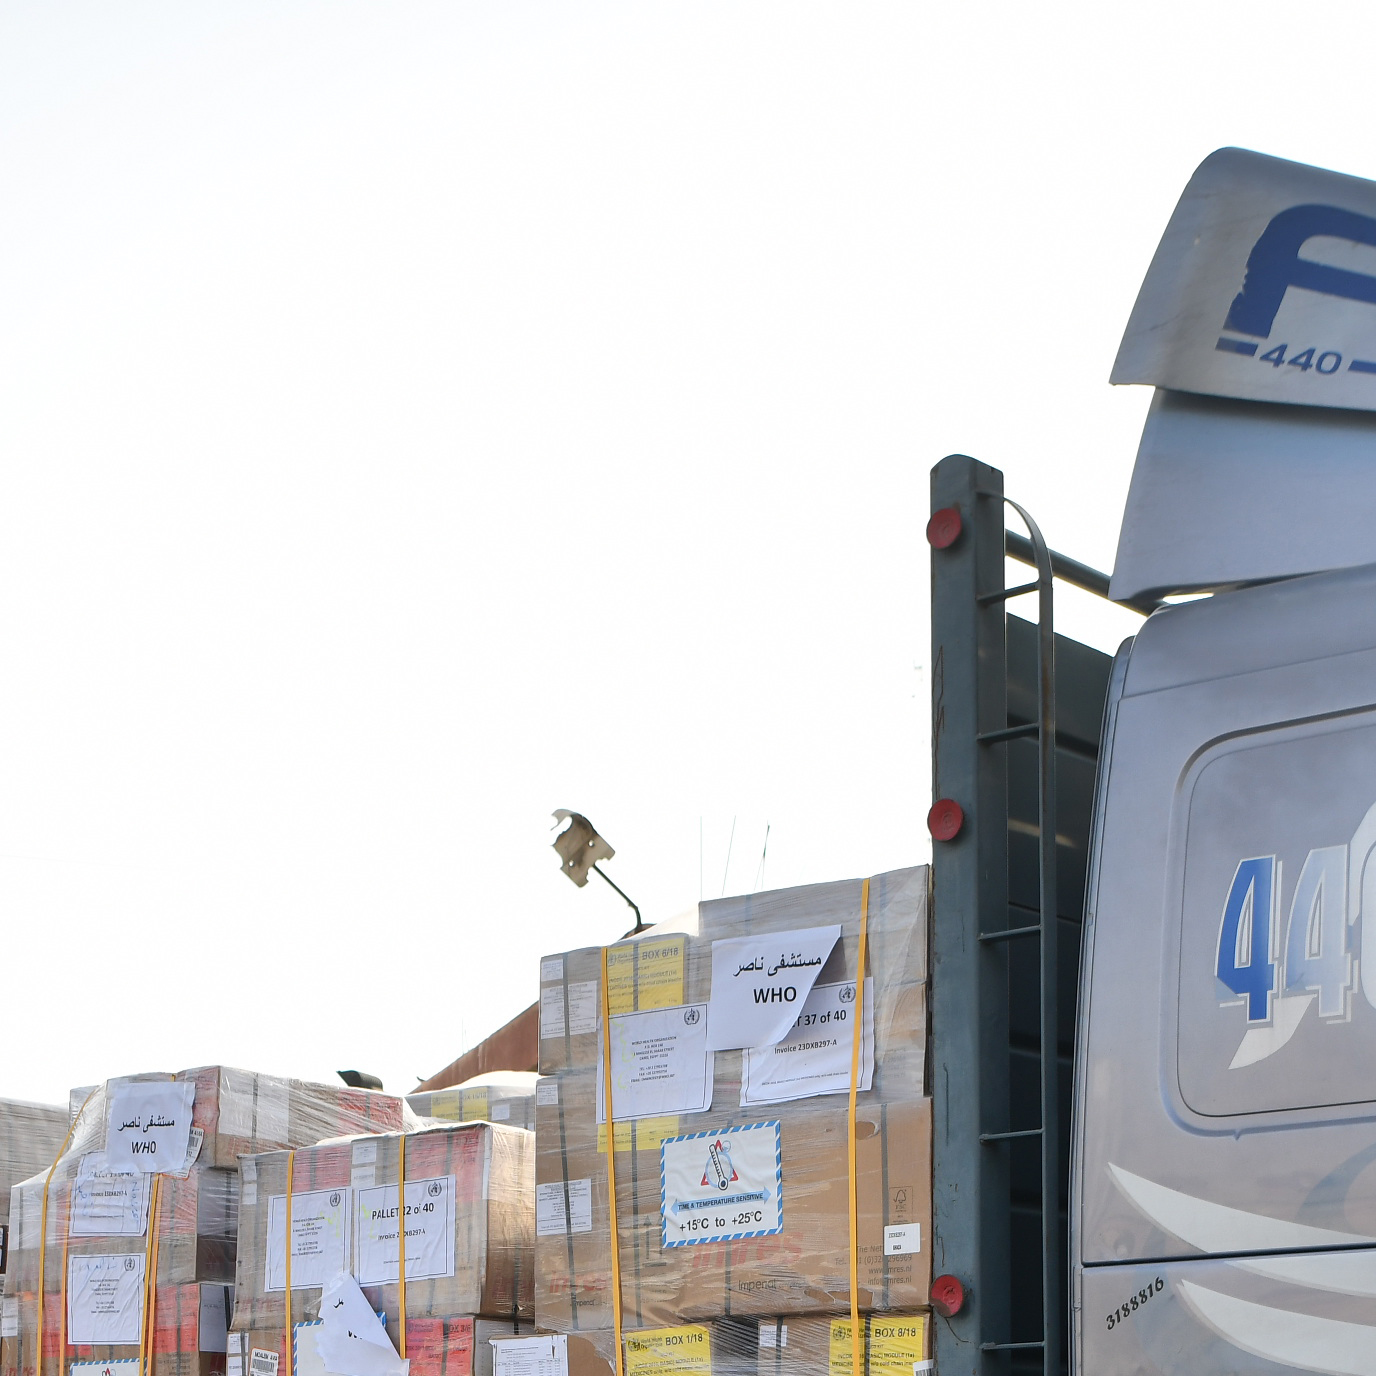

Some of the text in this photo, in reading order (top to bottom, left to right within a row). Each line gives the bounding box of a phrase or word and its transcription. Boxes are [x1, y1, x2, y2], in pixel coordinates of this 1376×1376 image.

[1258, 343, 1344, 376] 440
[733, 953, 821, 977] مستشفى ناصر
[753, 986, 797, 1004] WHO
[804, 1014, 816, 1027] 37
[820, 1012, 831, 1025] of
[833, 1009, 847, 1021] 40
[775, 1045, 796, 1055] Invoice
[117, 1115, 175, 1132] مستشفى ناصر
[678, 1202, 692, 1211] TIME
[696, 1196, 735, 1209] TEMPERATURE
[735, 1192, 764, 1203] SENSITIVE
[372, 1208, 399, 1221] PALLET
[422, 1202, 434, 1213] 40
[714, 1216, 726, 1228] to
[1106, 1276, 1165, 1331] 3188816
[665, 1336, 684, 1346] BOX
[686, 1333, 703, 1344] 1/18
[874, 1328, 917, 1338] BOX 8/18
